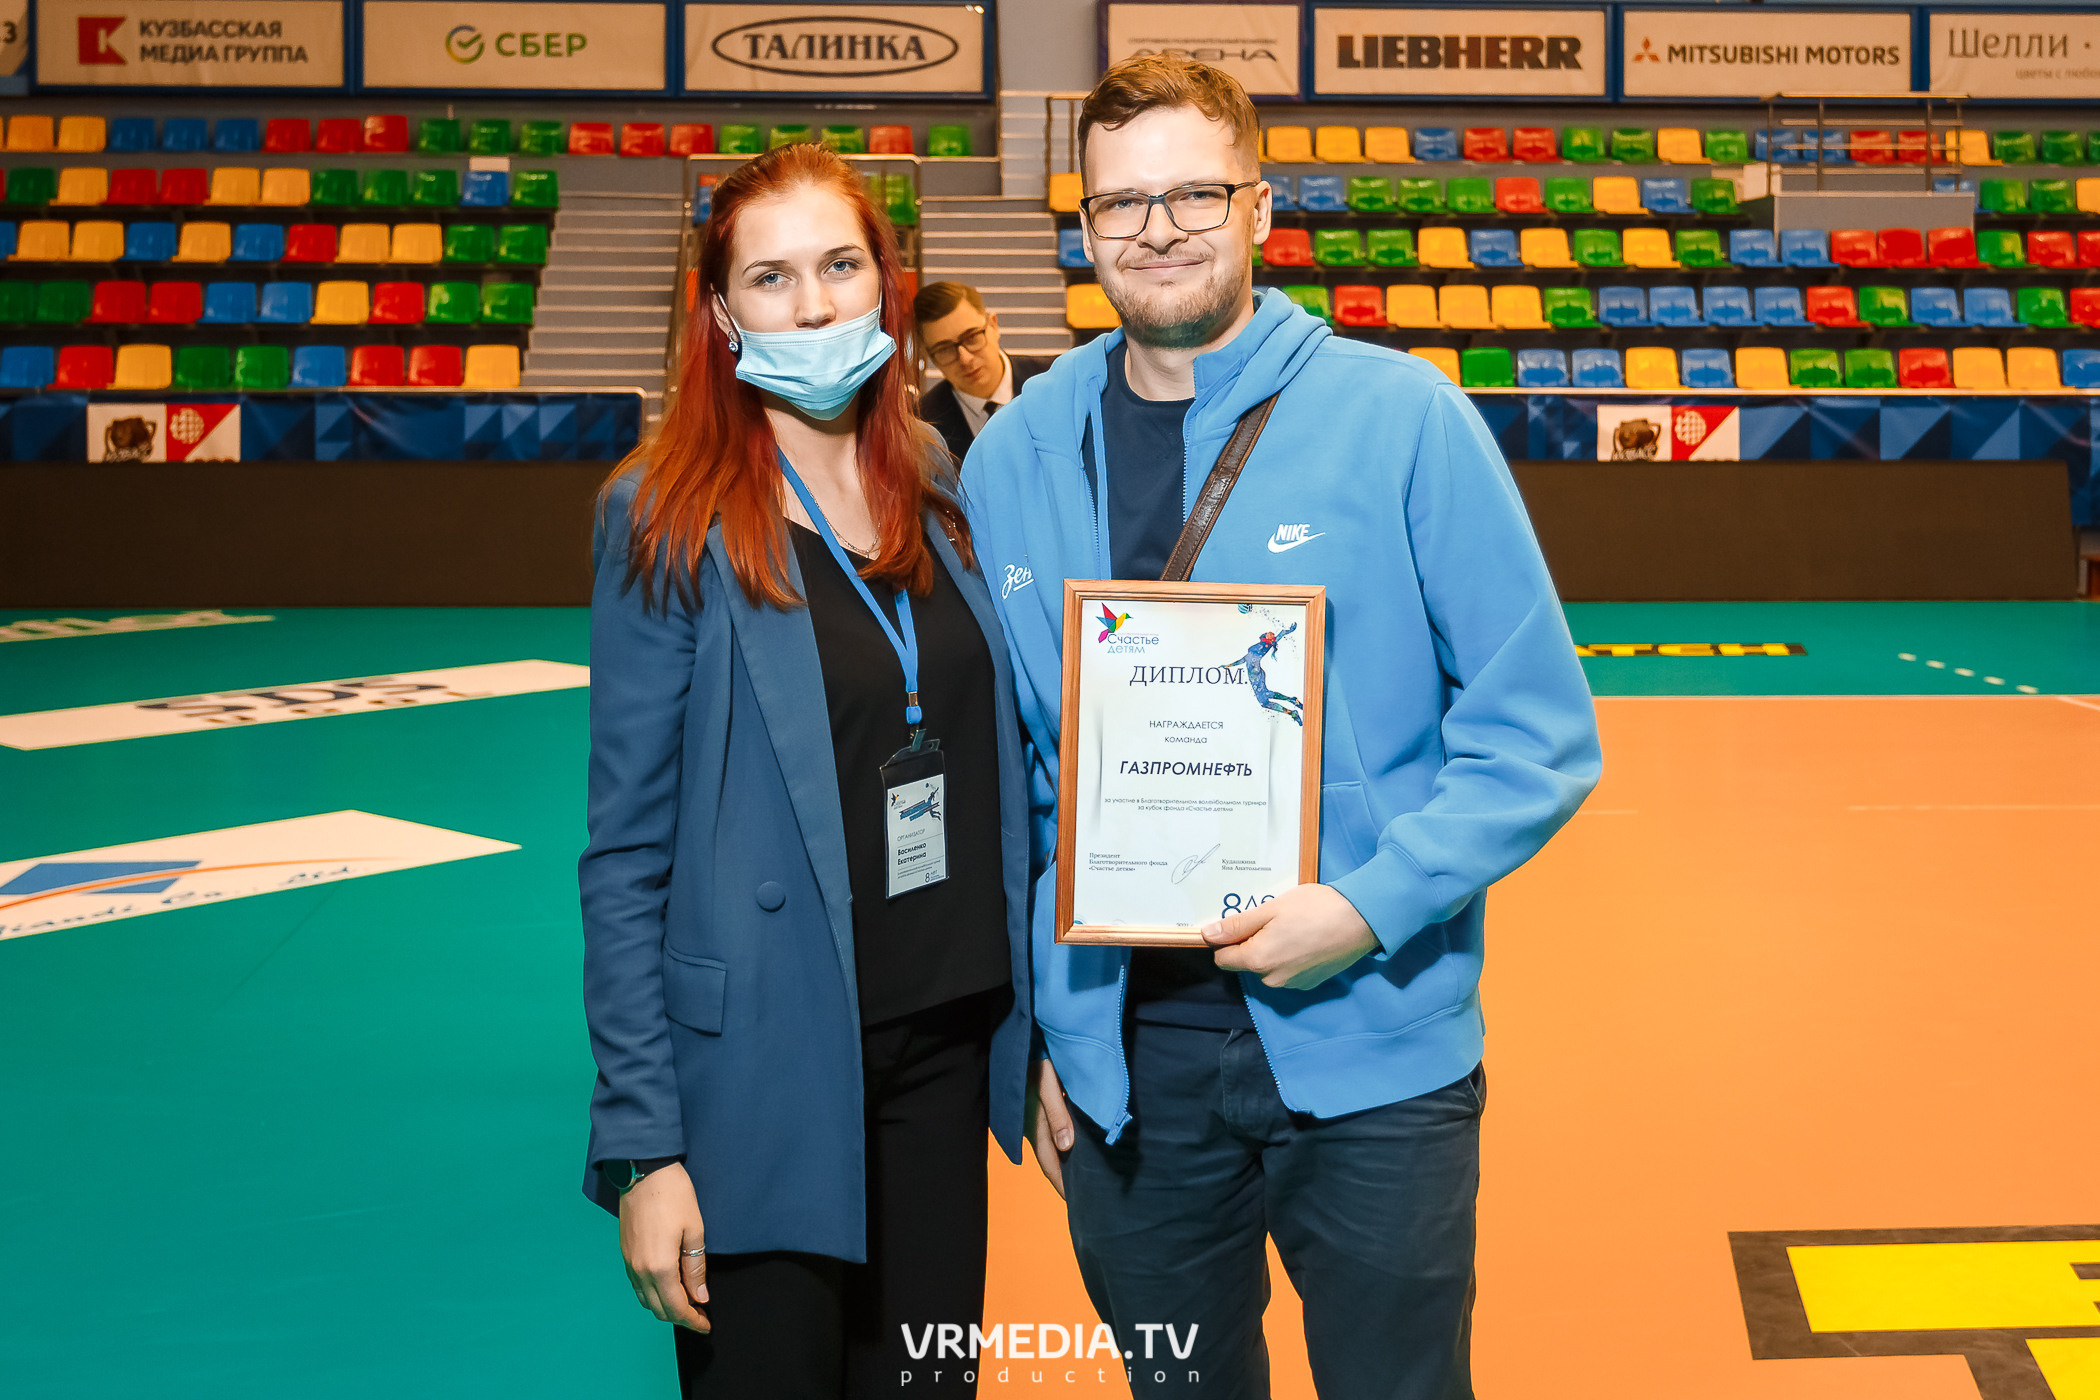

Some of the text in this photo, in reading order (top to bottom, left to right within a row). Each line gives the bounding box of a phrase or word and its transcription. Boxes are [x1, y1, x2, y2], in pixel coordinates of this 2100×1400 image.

[139, 19, 283, 38] КУЗБАССКАЯ
[494, 32, 588, 58] СБЕР
[743, 33, 928, 61] ТАЛИНКА
[1336, 34, 1583, 70] LIEBHERR
[1949, 27, 2069, 59] Шелли
[140, 44, 309, 65] МЕДИА ГРУППА
[1667, 44, 1900, 65] MITSUBISHI MOTORS
[1275, 523, 1311, 541] NIKE
[1107, 633, 1160, 645] Счастье
[1107, 645, 1146, 654] детям
[1149, 720, 1224, 730] НАГРАЖДАЕТСЯ
[1164, 736, 1208, 744] команда
[1119, 760, 1253, 777] ГАЗПРОМНЕФТЬ
[897, 842, 927, 856] Василенко
[897, 851, 927, 866] Екатерина
